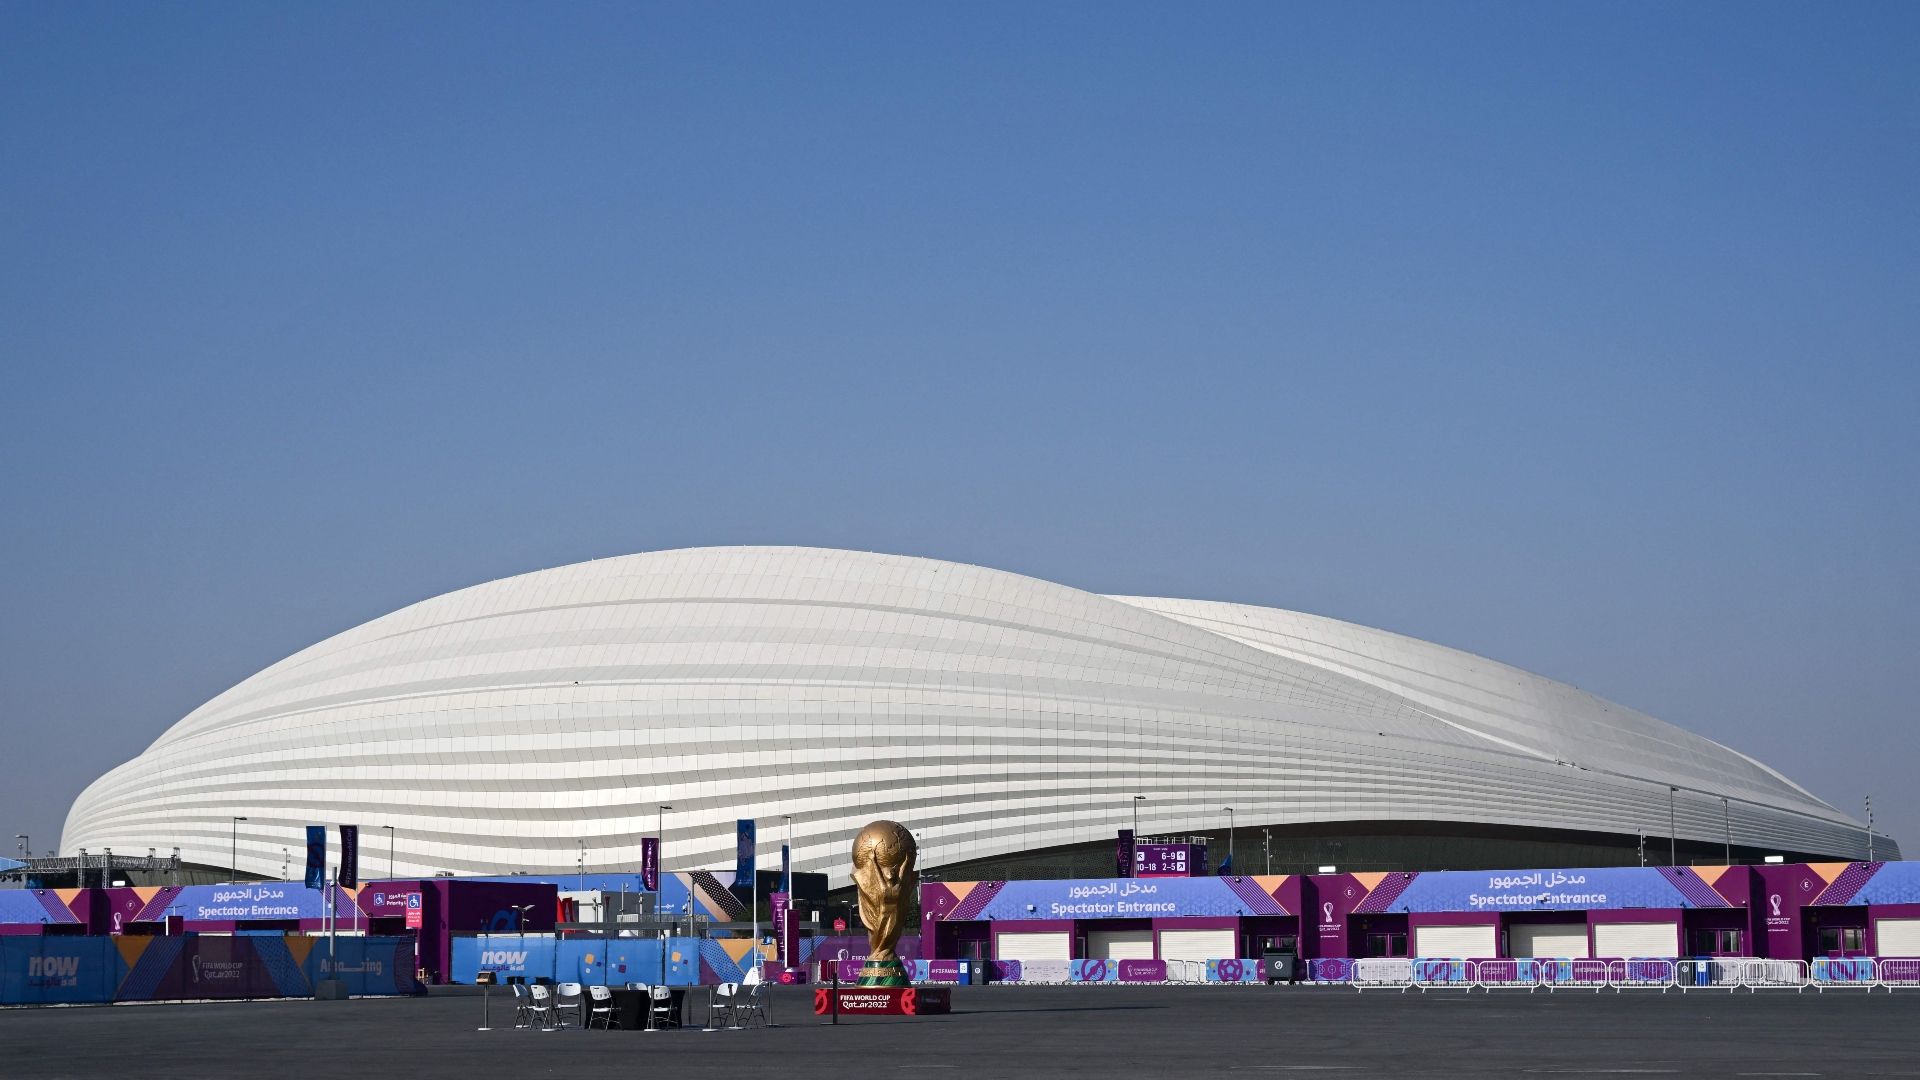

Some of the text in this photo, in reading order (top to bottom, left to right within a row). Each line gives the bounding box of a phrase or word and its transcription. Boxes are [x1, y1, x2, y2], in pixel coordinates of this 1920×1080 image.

[1489, 872, 1586, 889] مدخل الجمهور
[212, 887, 285, 903] مدخل الجمهور
[1069, 881, 1158, 898] مدخل الجمهور
[1469, 892, 1607, 908] Spectator Entrance
[198, 905, 299, 919] Spectator Entrance
[1051, 902, 1176, 916] Spectator Entrance
[481, 951, 528, 965] now
[29, 956, 80, 977] now
